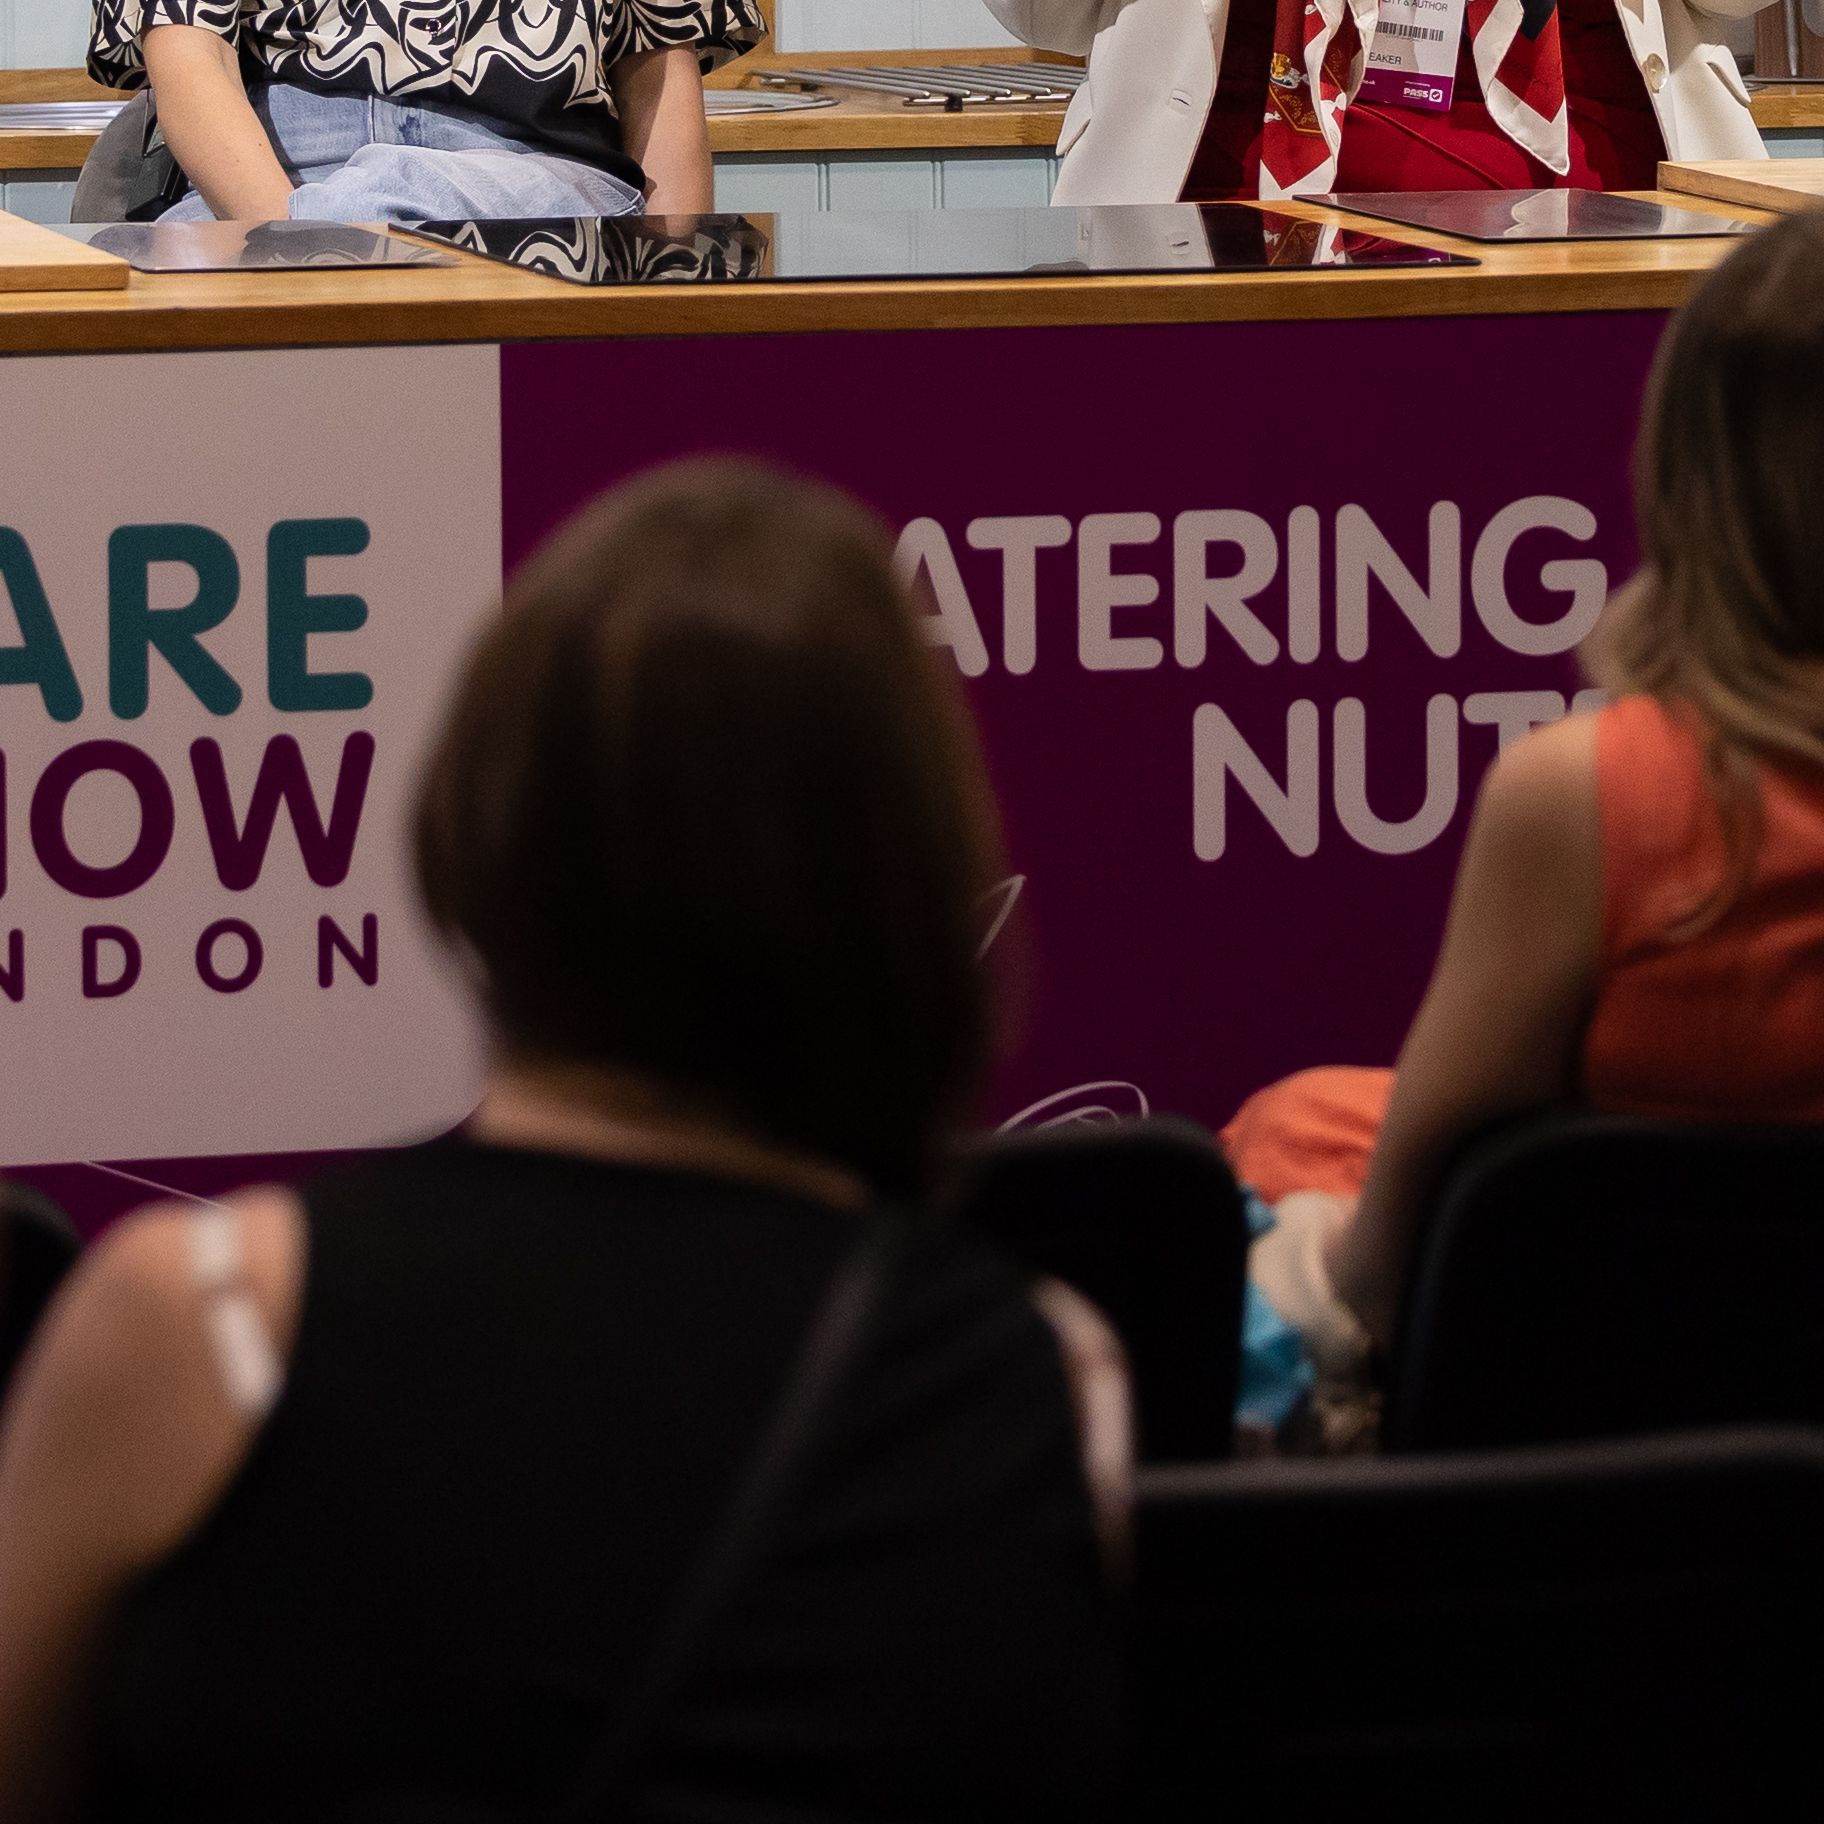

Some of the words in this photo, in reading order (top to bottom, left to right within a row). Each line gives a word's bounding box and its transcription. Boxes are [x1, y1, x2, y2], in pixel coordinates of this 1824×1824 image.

[1411, 0, 1448, 12] AUTHOR
[1368, 51, 1402, 65] EAKER
[888, 494, 1609, 678] ATERING
